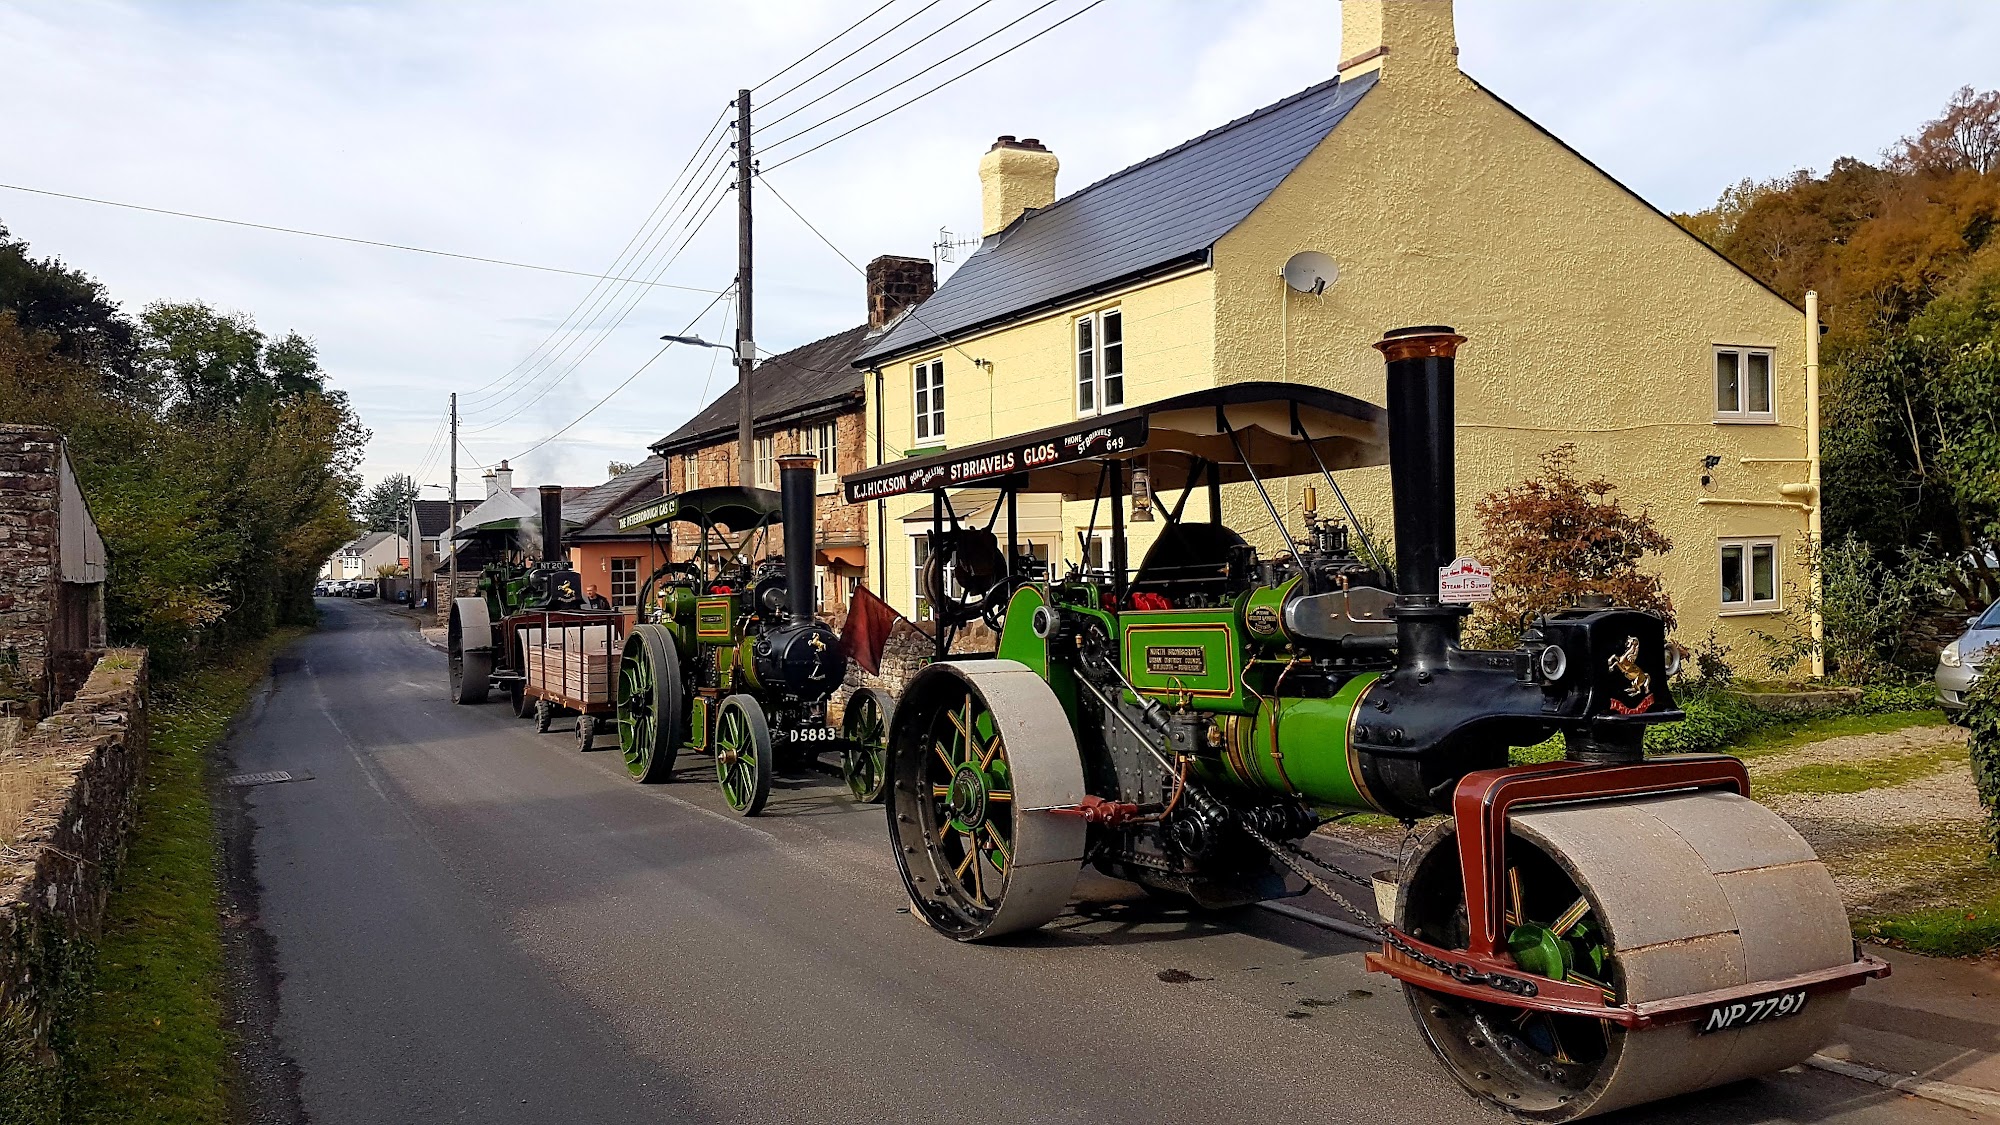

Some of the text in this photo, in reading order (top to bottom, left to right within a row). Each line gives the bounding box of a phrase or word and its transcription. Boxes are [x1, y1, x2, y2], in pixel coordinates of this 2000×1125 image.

[1064, 434, 1082, 446] PHONE
[1106, 436, 1124, 451] 649
[1023, 443, 1059, 464] GLOS.
[909, 468, 924, 484] ROAD
[921, 465, 945, 487] ROLLING
[618, 518, 627, 530] THE
[658, 503, 669, 516] GAS
[1705, 991, 1806, 1031] NP 7791
